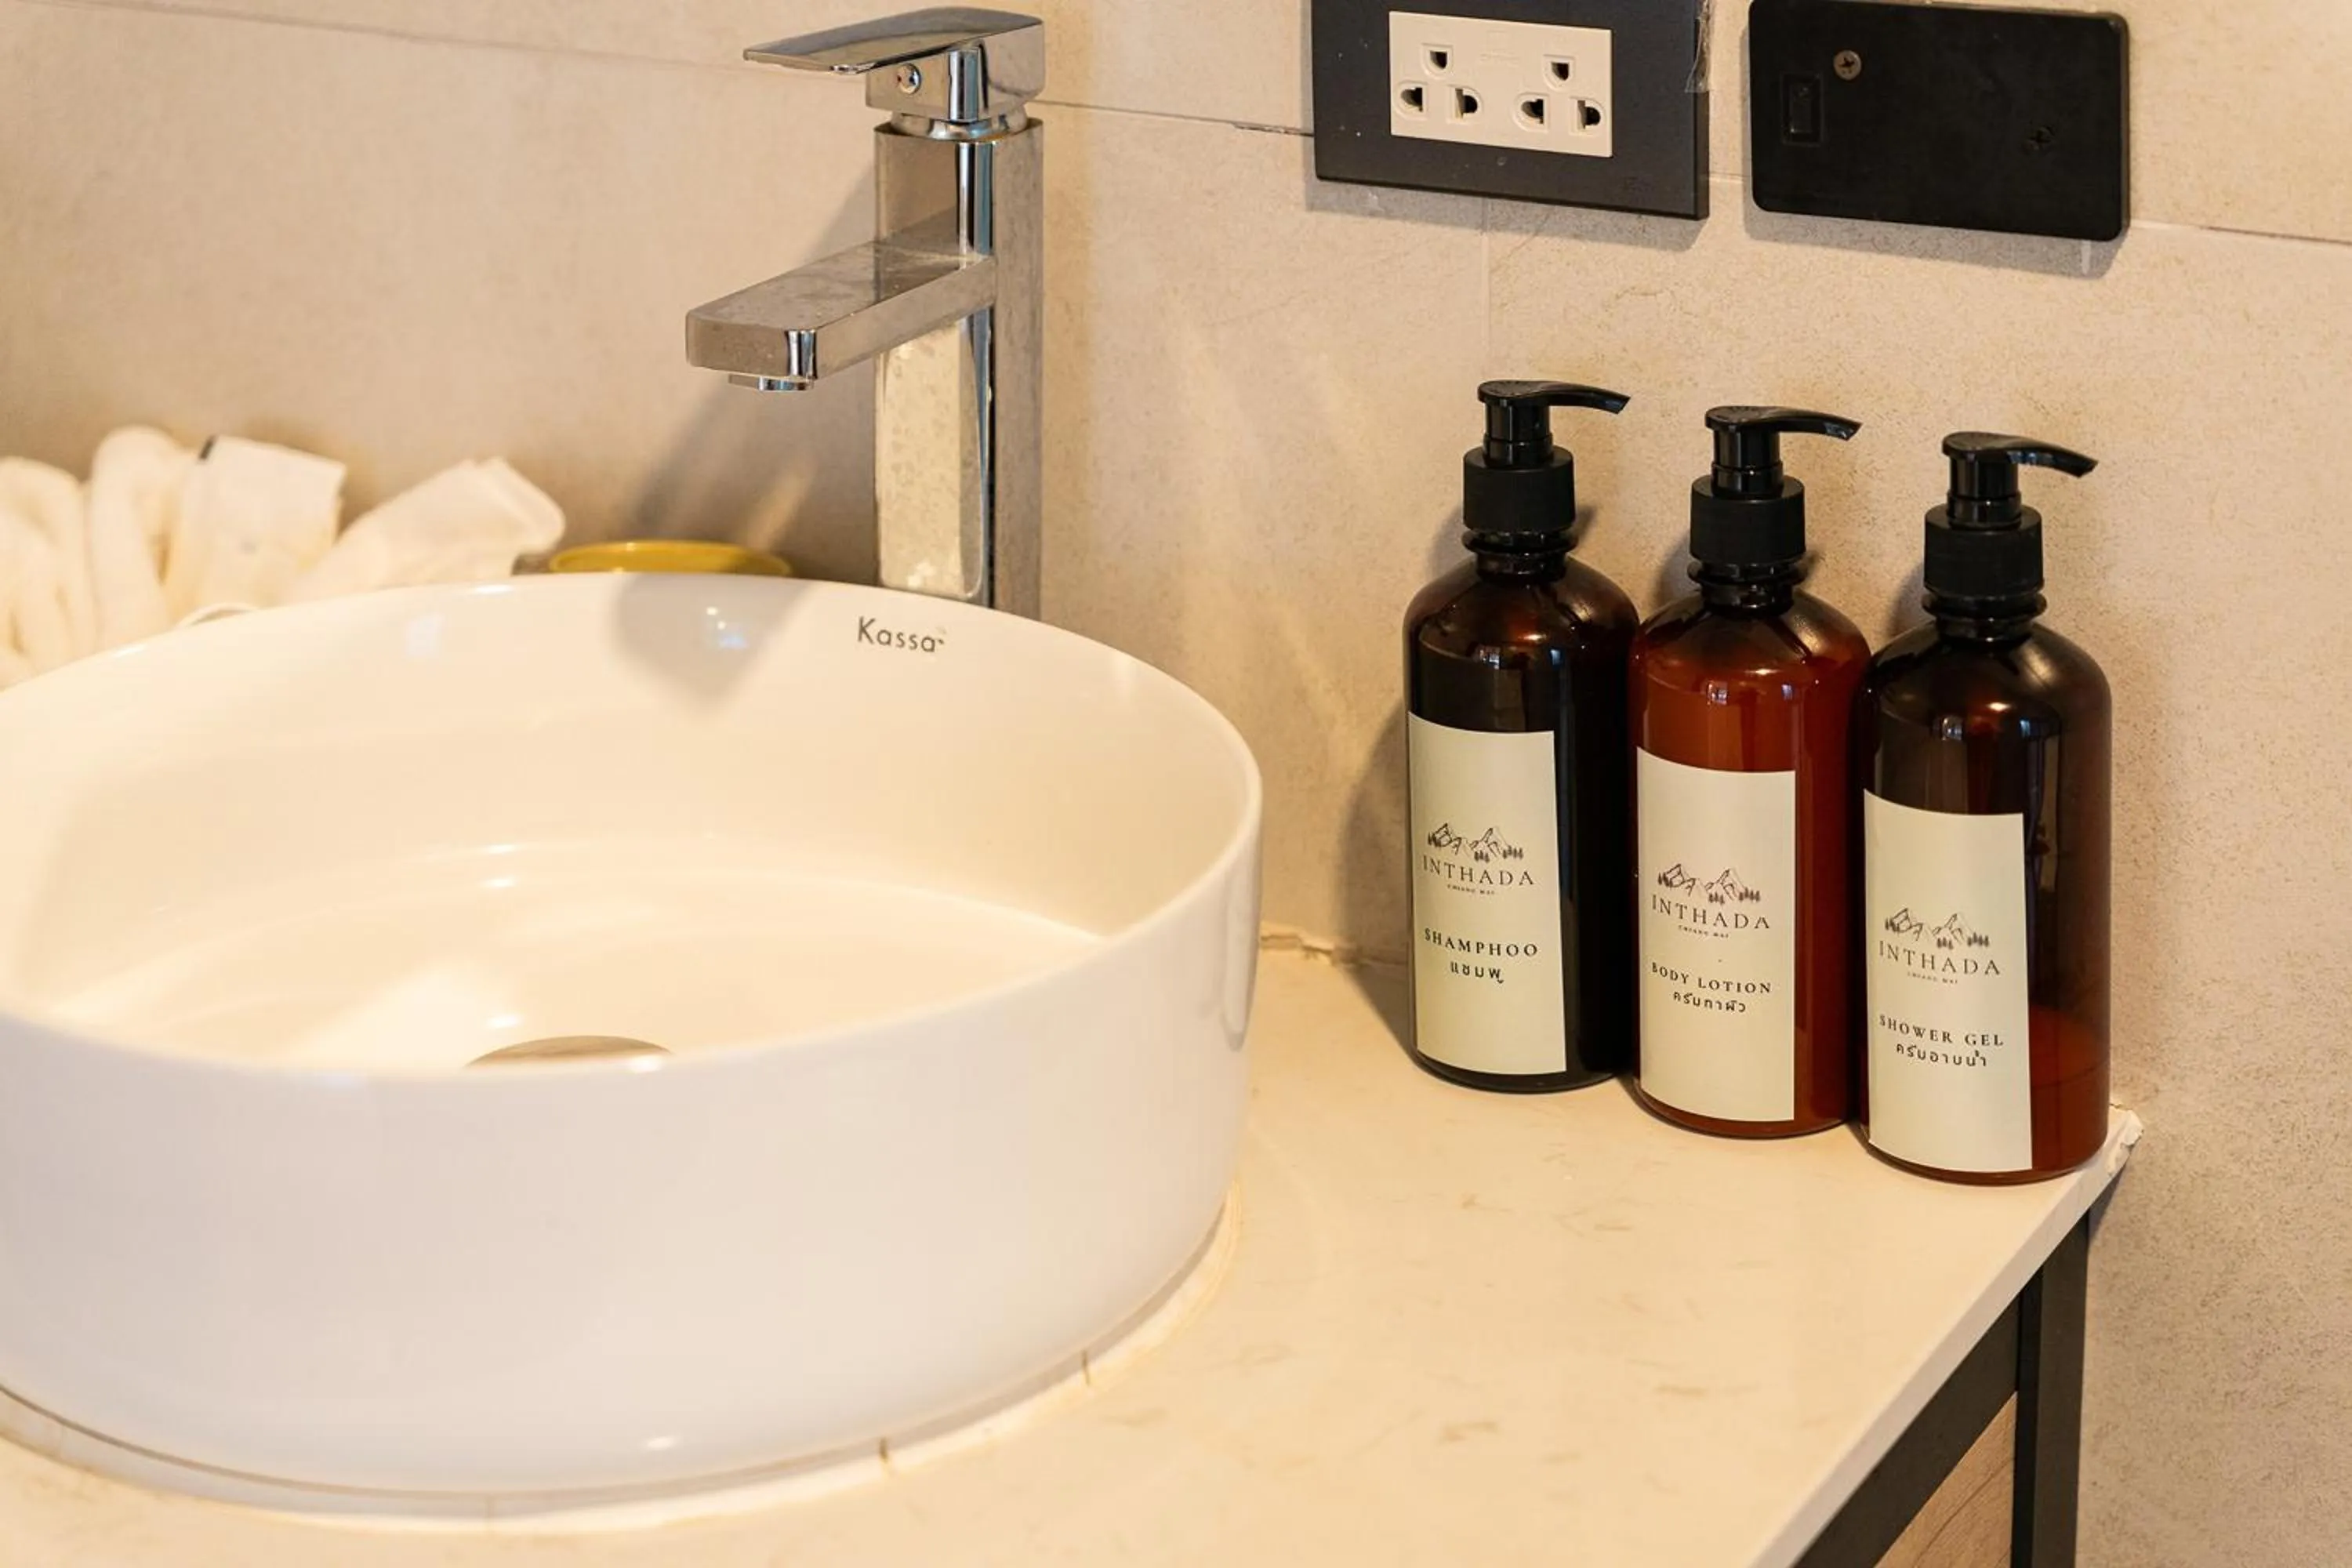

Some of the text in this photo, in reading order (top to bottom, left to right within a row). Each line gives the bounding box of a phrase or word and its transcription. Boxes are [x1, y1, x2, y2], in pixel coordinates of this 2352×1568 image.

[857, 615, 936, 653] Kassa
[1422, 854, 1535, 886] INTHADA
[1651, 894, 1771, 930] INTHADA
[1424, 927, 1538, 957] SHAMPHOO
[1878, 940, 2002, 976] INTHADA
[1450, 960, 1504, 984] แชมพู
[1651, 961, 1772, 994] BODY LOTION
[1879, 1014, 2004, 1047] SHOWER GEL
